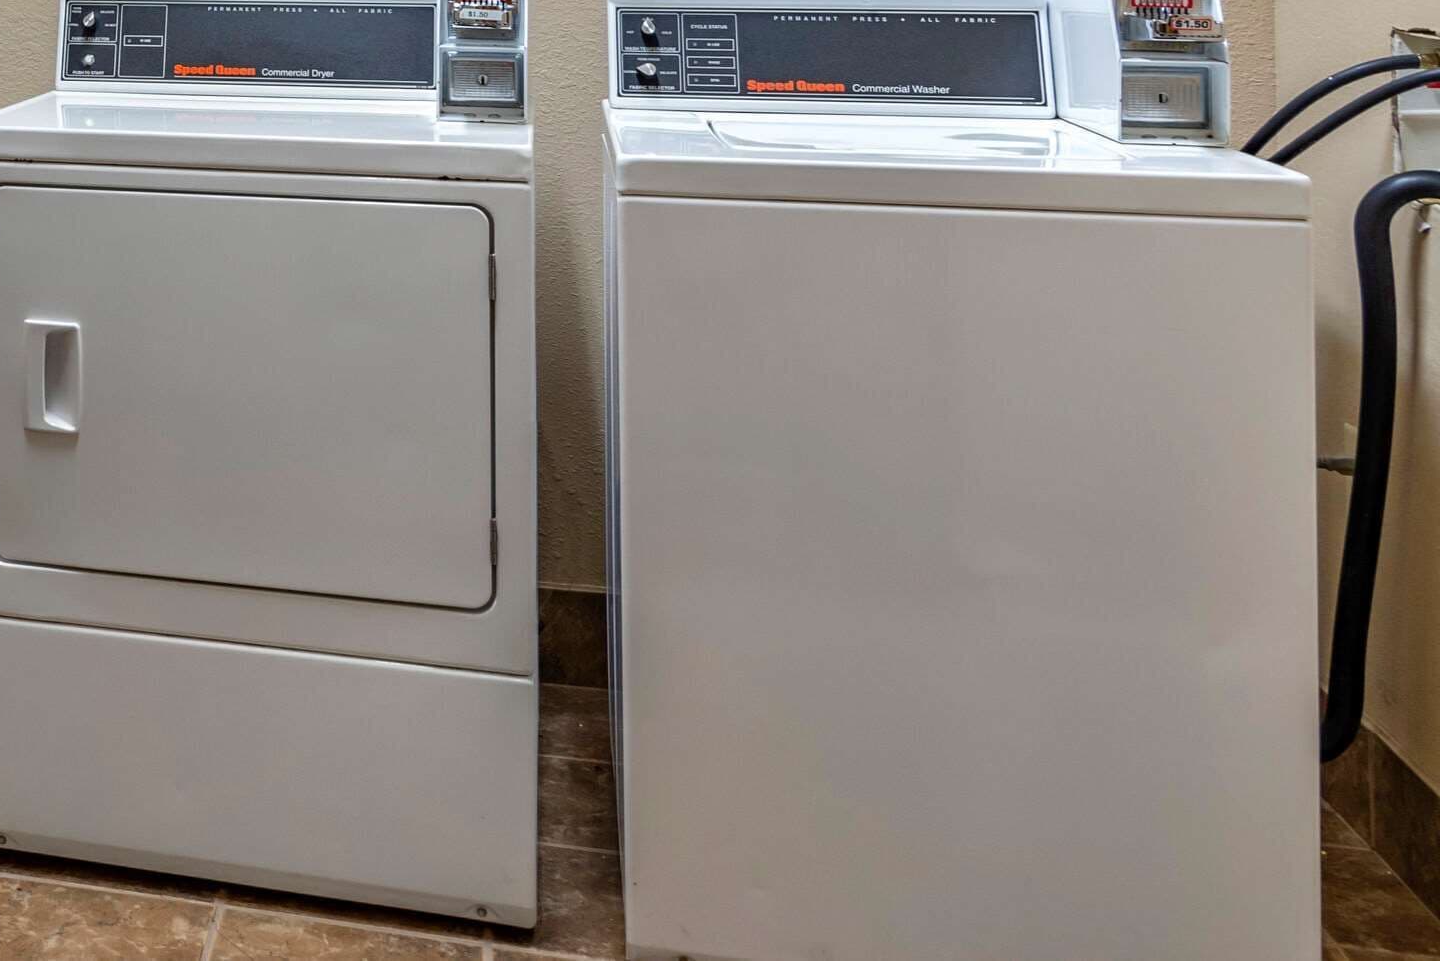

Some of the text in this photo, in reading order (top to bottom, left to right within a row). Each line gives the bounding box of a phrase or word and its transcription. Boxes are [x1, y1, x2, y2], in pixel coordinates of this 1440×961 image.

[468, 10, 489, 18] $1.50
[852, 15, 888, 23] PRESS
[1175, 20, 1209, 29] $1.50
[173, 63, 335, 79] Speed Queen Commercial Dryer
[746, 79, 951, 94] Speed Queen Commercial Washer
